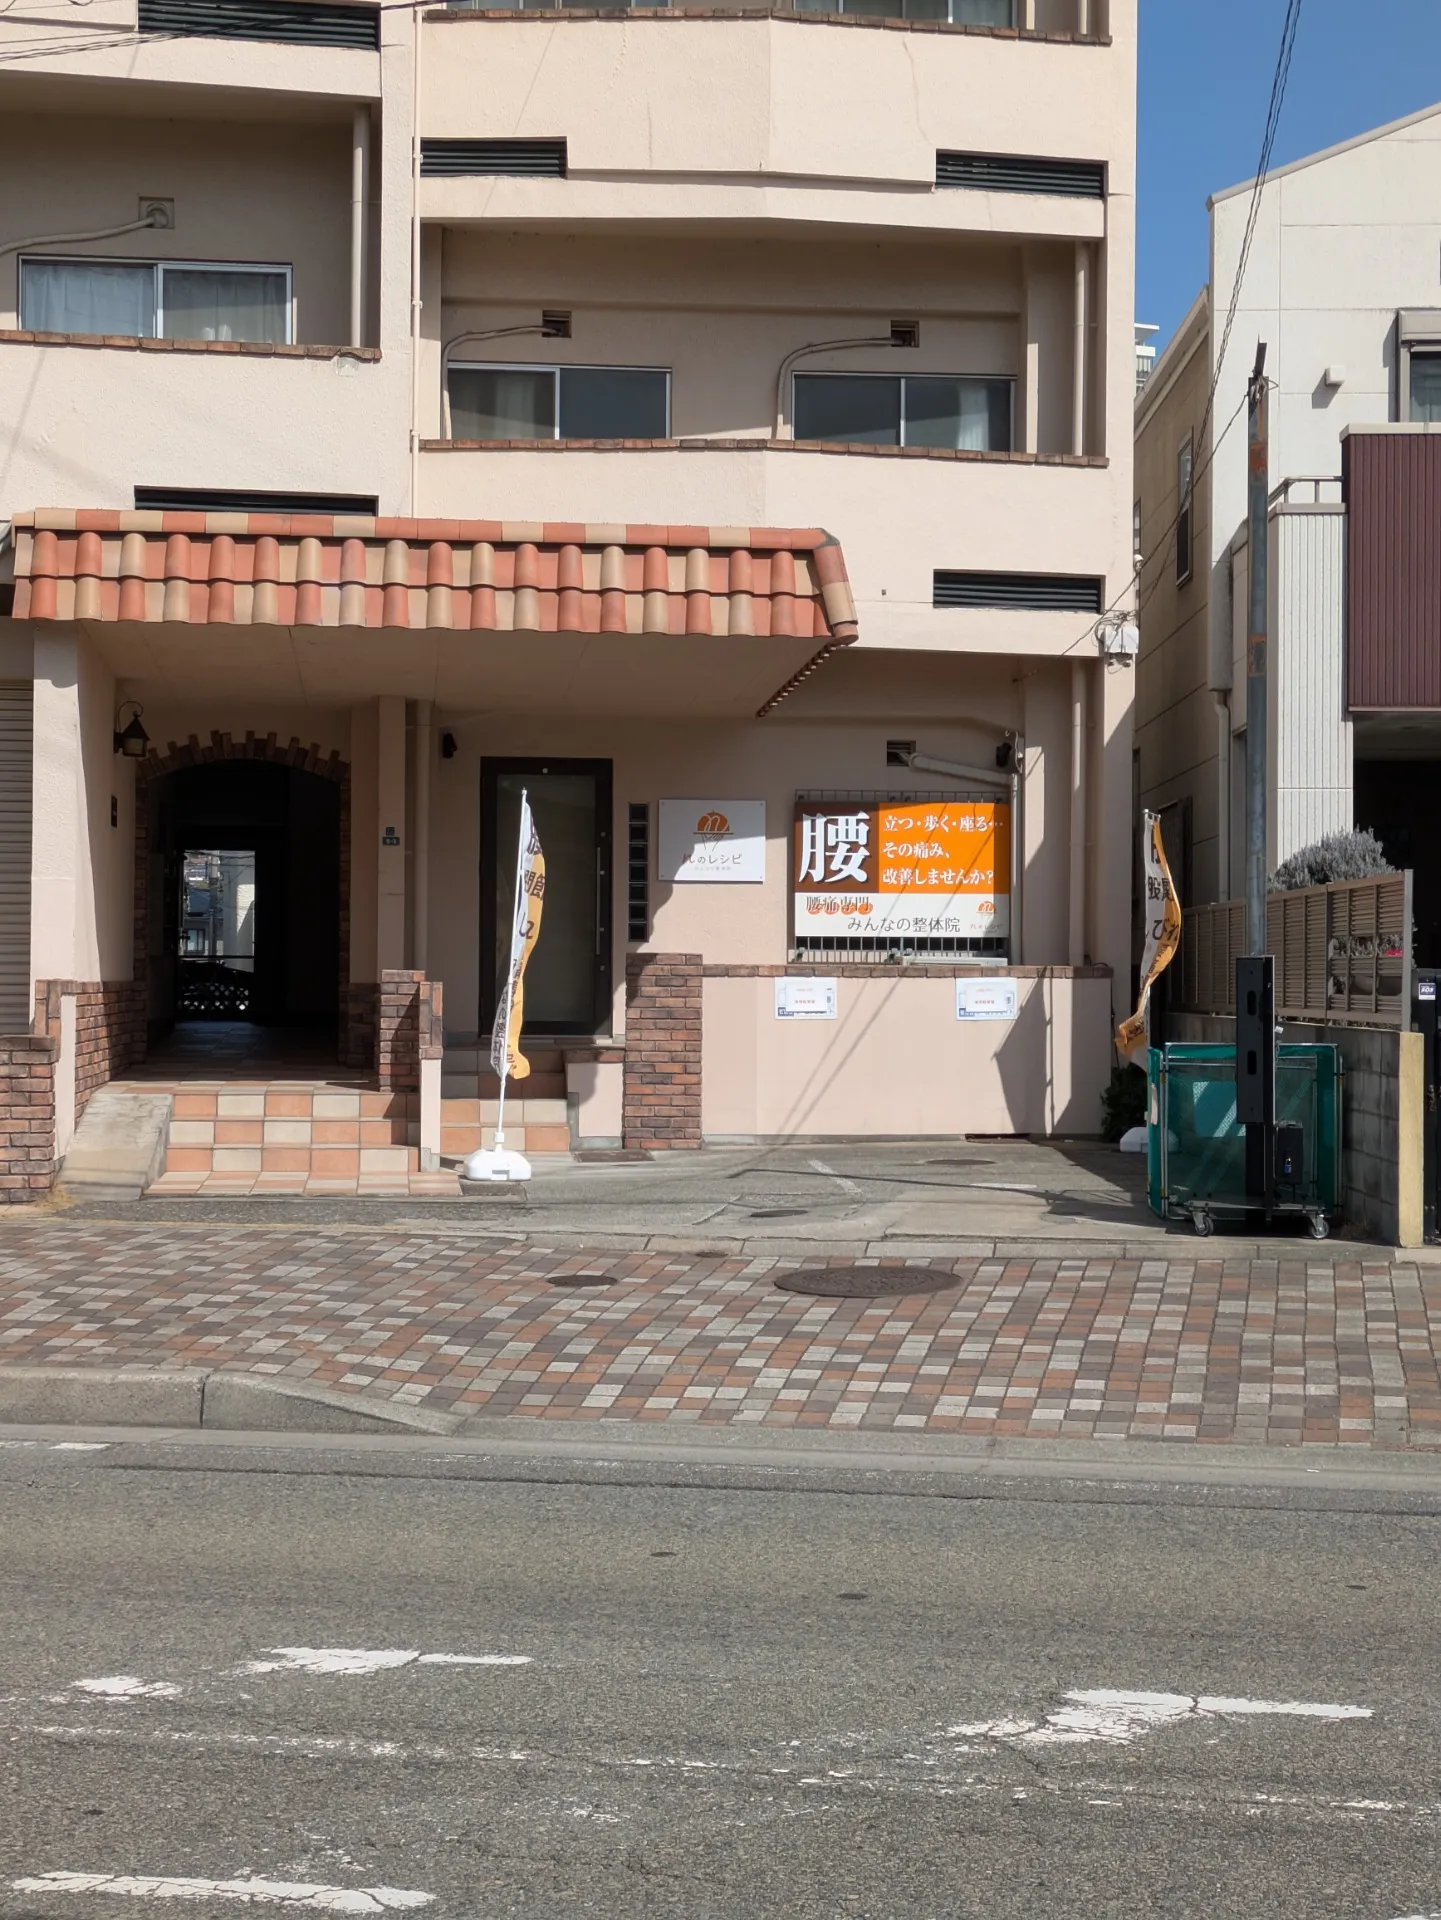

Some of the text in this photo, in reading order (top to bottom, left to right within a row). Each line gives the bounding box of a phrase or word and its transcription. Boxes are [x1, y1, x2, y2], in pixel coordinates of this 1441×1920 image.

[798, 810, 871, 883] 腰
[882, 841, 950, 859] その痛み、
[882, 867, 994, 885] 改善しませんか?
[847, 917, 961, 933] みんなの整体院
